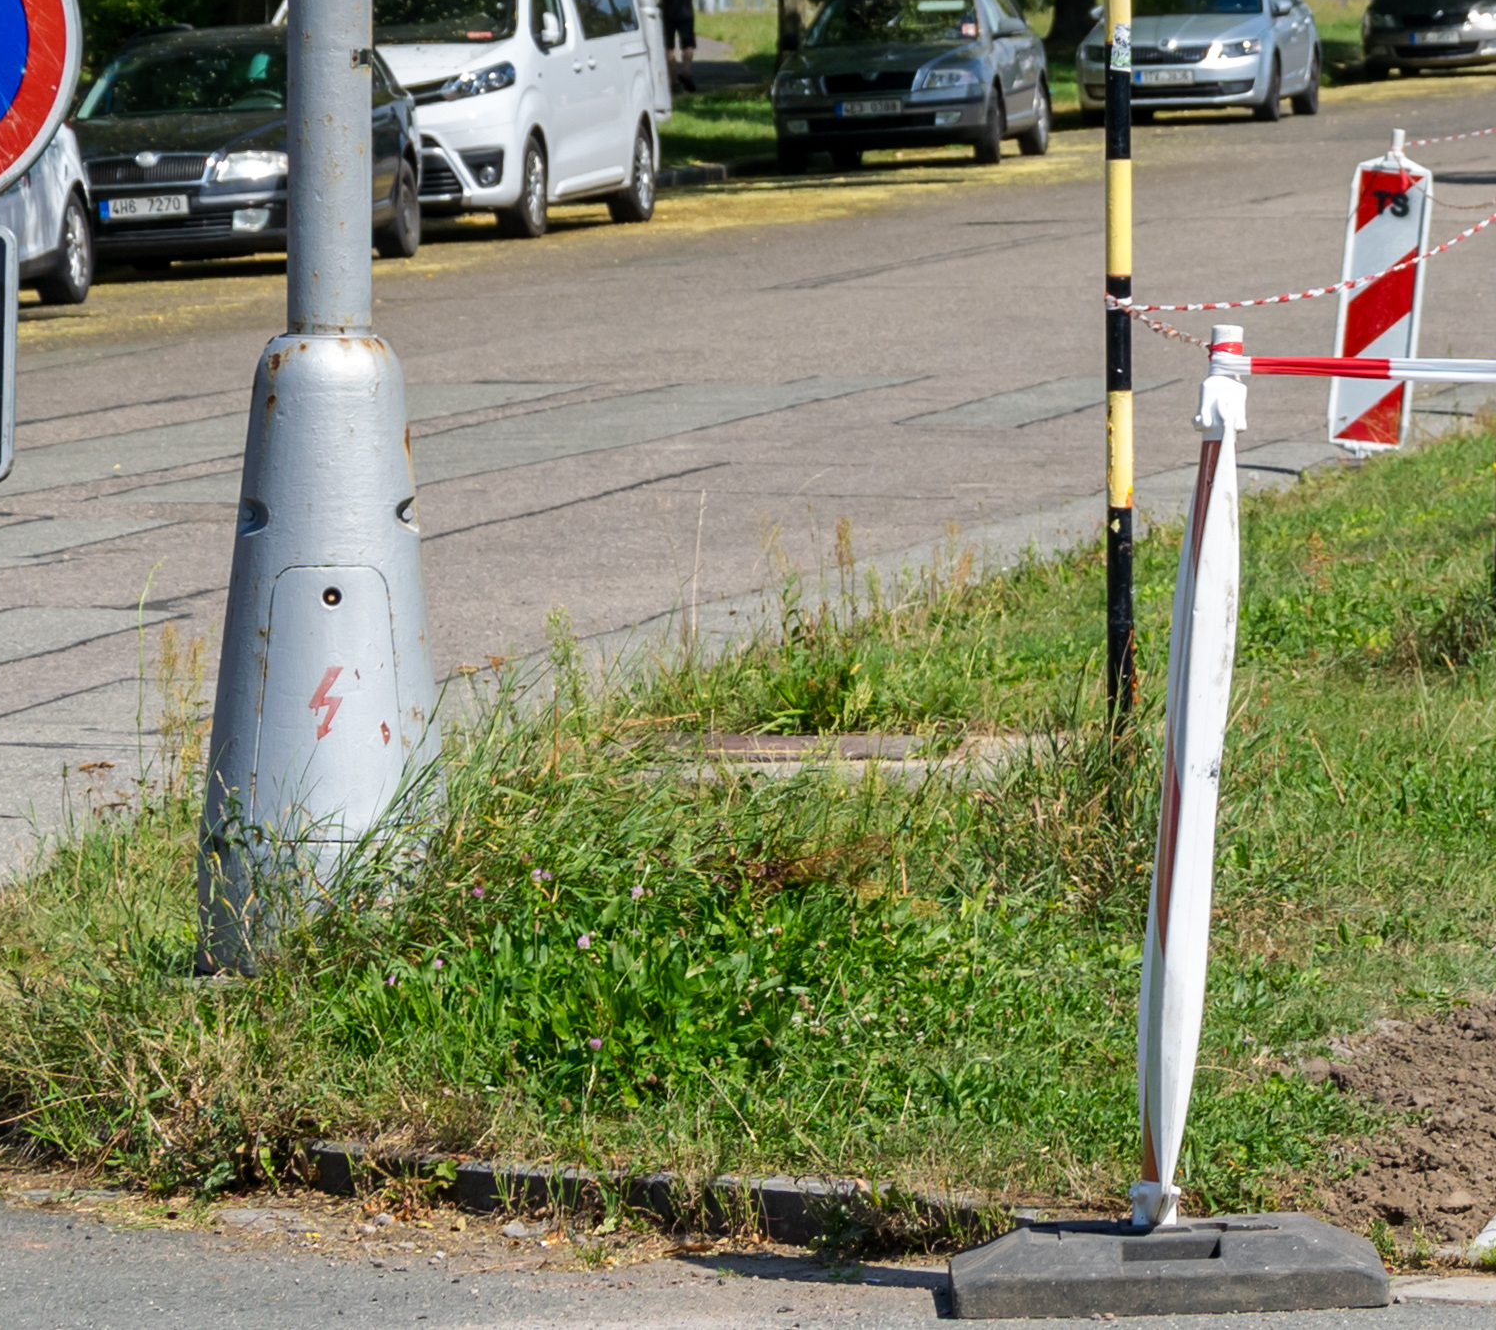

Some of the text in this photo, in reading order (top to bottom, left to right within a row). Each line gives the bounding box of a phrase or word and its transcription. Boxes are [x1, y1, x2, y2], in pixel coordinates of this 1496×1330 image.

[112, 196, 181, 214] 4H6 7270
[1372, 190, 1410, 218] TS
